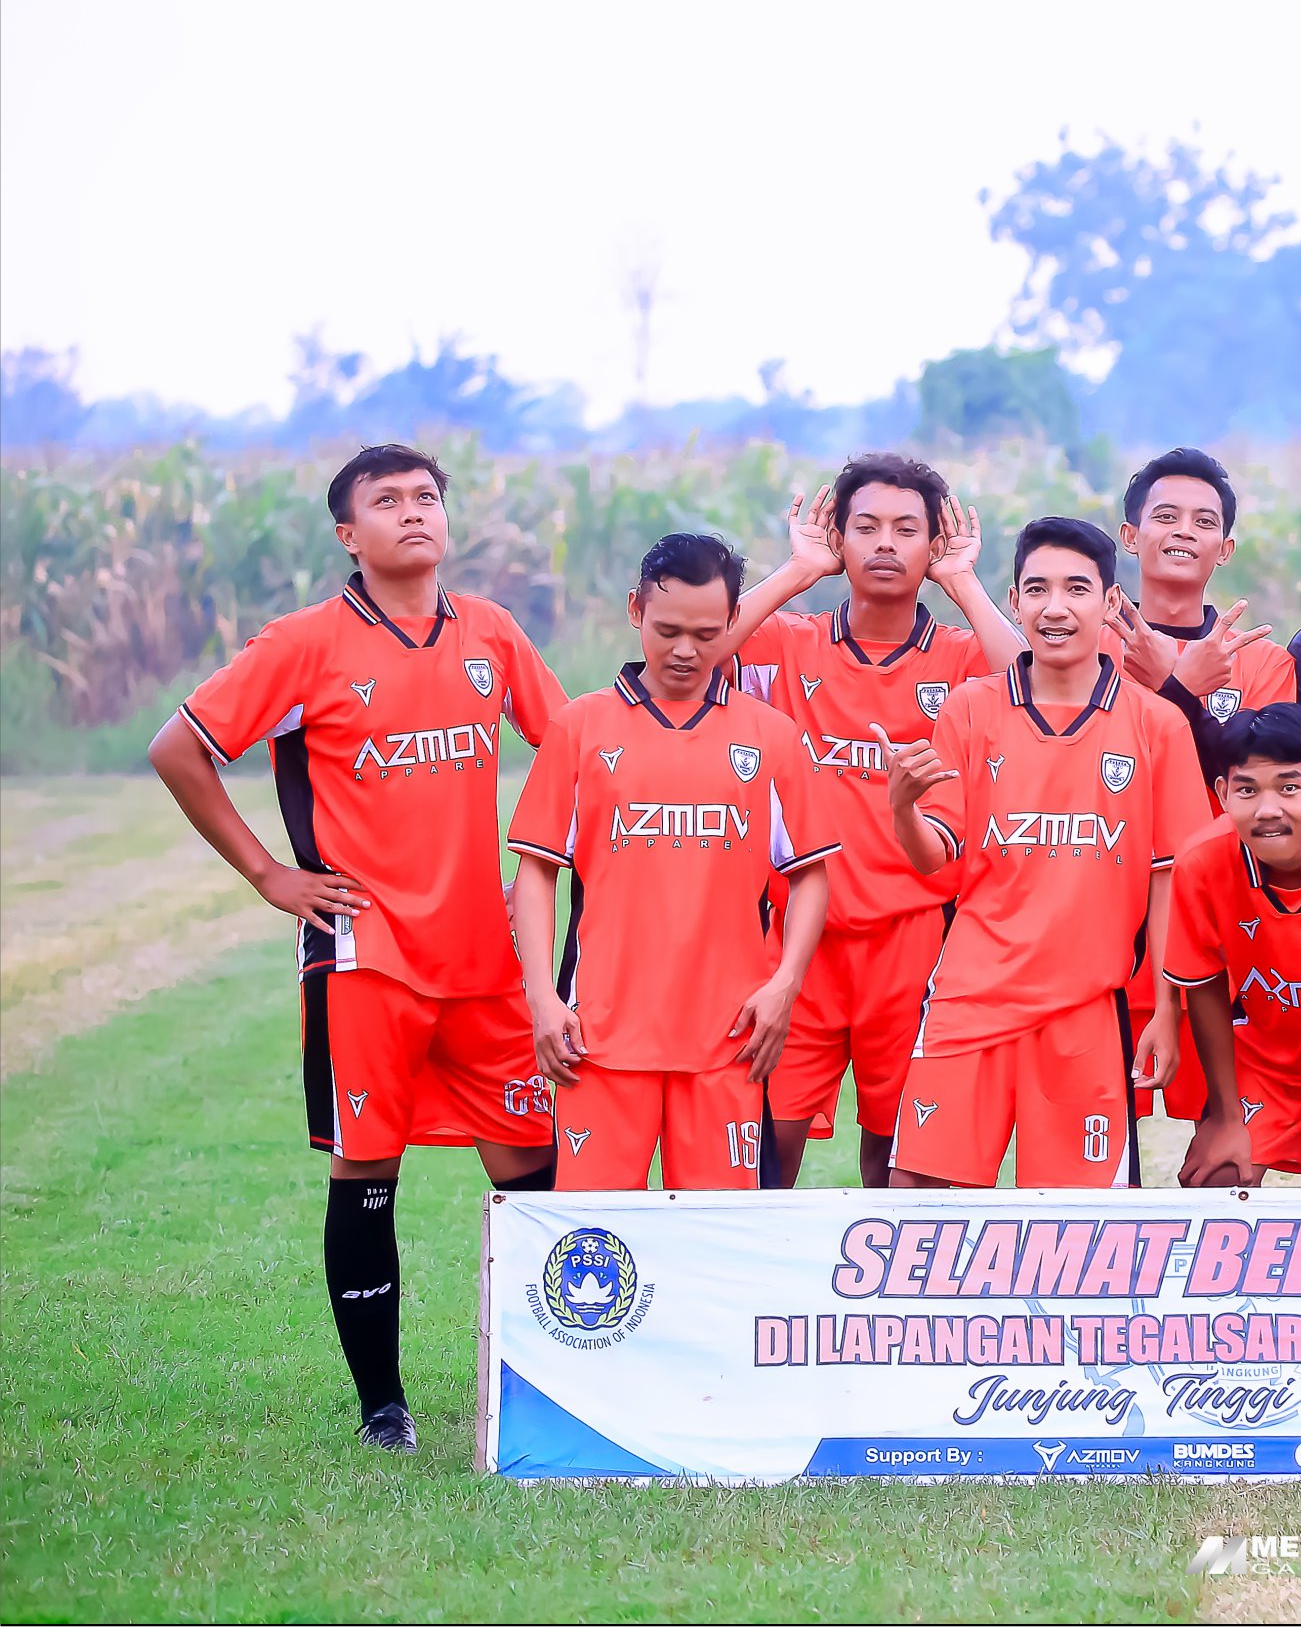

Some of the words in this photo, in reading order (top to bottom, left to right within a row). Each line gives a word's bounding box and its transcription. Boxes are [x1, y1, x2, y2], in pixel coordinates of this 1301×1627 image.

[353, 723, 496, 771] AZMOV
[801, 730, 913, 771] AZM
[355, 759, 484, 781] APPARE
[610, 802, 751, 842] AZMOV
[981, 811, 1127, 853] AZMOV
[612, 839, 732, 853] APPARE
[1001, 847, 1124, 865] PPAREL
[1083, 1113, 1109, 1163] 8
[570, 1253, 611, 1268] PSSI
[832, 1218, 1191, 1299] SELAMAT
[525, 1283, 552, 1330] FOOTBALL
[548, 1327, 612, 1351] ASSOCIATION
[612, 1328, 626, 1343] OF
[624, 1283, 656, 1333] INDONESIA
[754, 1316, 808, 1367] DI
[815, 1314, 1065, 1366] LAPANGAN
[1207, 1365, 1279, 1377] NGKUNG
[952, 1374, 1137, 1426] Junjung
[1162, 1371, 1296, 1423] Tinggi
[865, 1448, 941, 1467] Support
[946, 1448, 971, 1466] By
[1066, 1449, 1140, 1464] AZMOV
[1173, 1443, 1256, 1460] BUMDES
[1173, 1459, 1256, 1468] KANGKUNG
